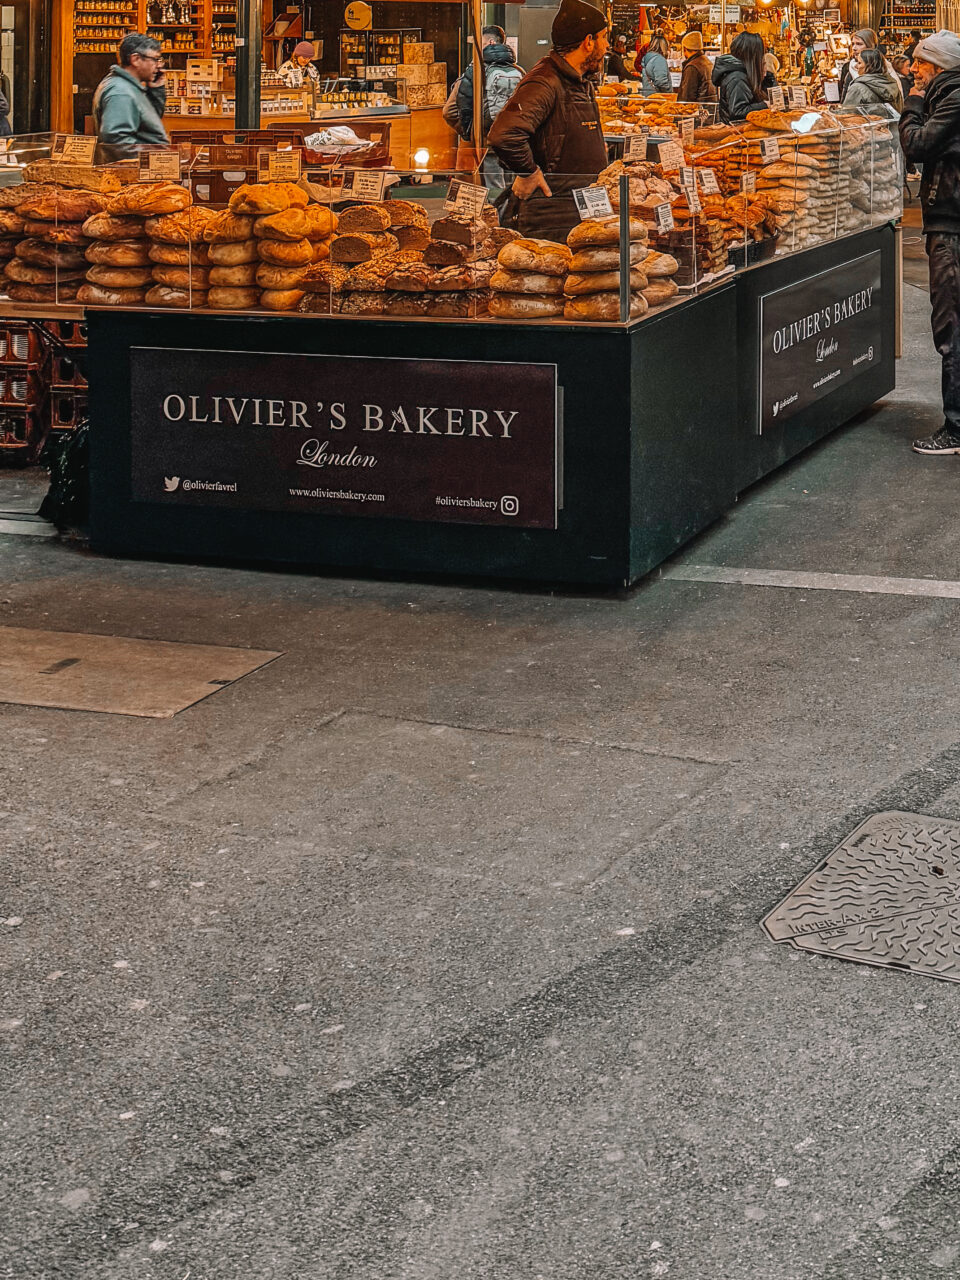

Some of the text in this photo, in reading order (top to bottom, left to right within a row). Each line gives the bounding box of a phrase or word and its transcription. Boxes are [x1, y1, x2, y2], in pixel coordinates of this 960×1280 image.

[773, 286, 873, 354] OLIVIER'S BAKERY
[162, 393, 520, 439] OLIVIER'S BAKERY
[296, 438, 378, 469] London
[182, 478, 238, 494] @olivierfavrel
[289, 487, 385, 503] www.oliviersbakery.com
[435, 495, 498, 511] #oliviersbakery
